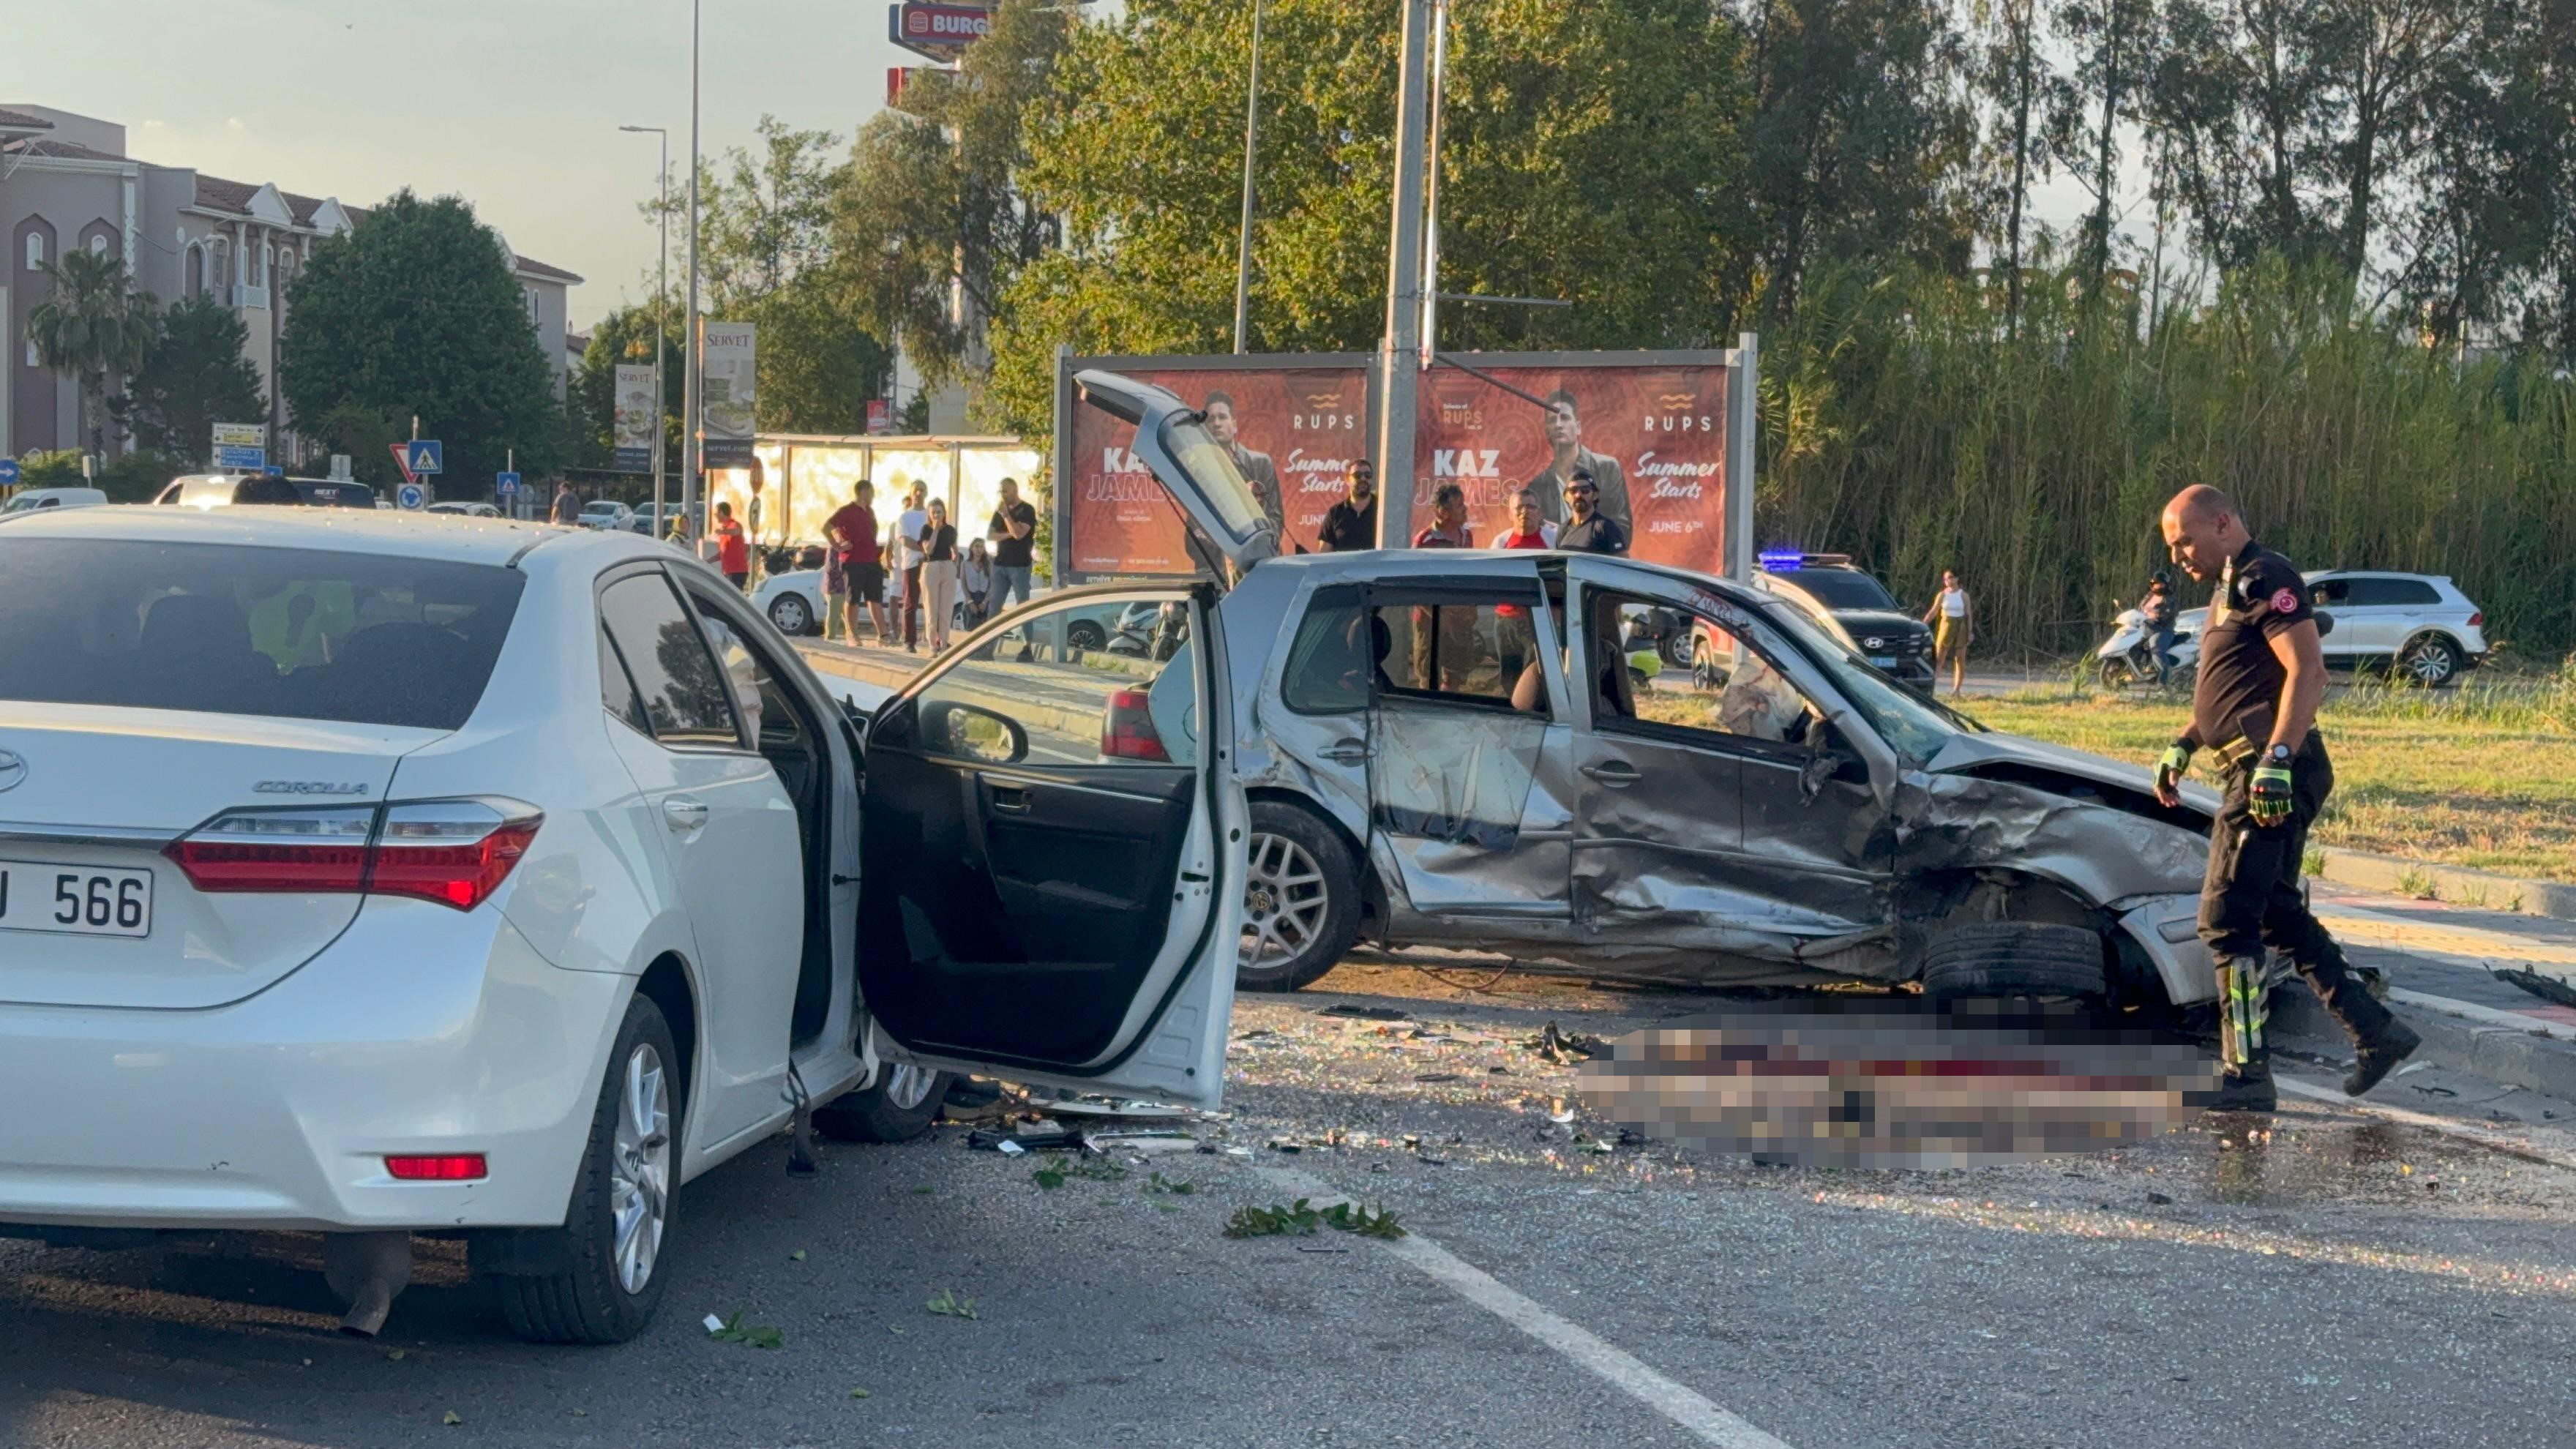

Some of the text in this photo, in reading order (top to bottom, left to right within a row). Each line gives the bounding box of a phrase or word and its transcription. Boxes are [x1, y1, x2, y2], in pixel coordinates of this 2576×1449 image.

[707, 334, 750, 348] SERVET
[619, 372, 651, 384] SERVET
[1293, 414, 1354, 430] RUPS
[1443, 411, 1482, 430] RUPS
[1644, 415, 1711, 432] RUPS
[1104, 447, 1151, 473] KA
[1284, 448, 1351, 473] Summe
[1434, 449, 1500, 476] KAZ
[1633, 451, 1721, 477] Summer
[1086, 473, 1177, 501] JAME
[1300, 472, 1345, 493] Starts
[1650, 476, 1703, 499] Starts
[1649, 520, 1682, 533] JUNE
[252, 780, 369, 795] COROLLA
[54, 874, 143, 928] 566
